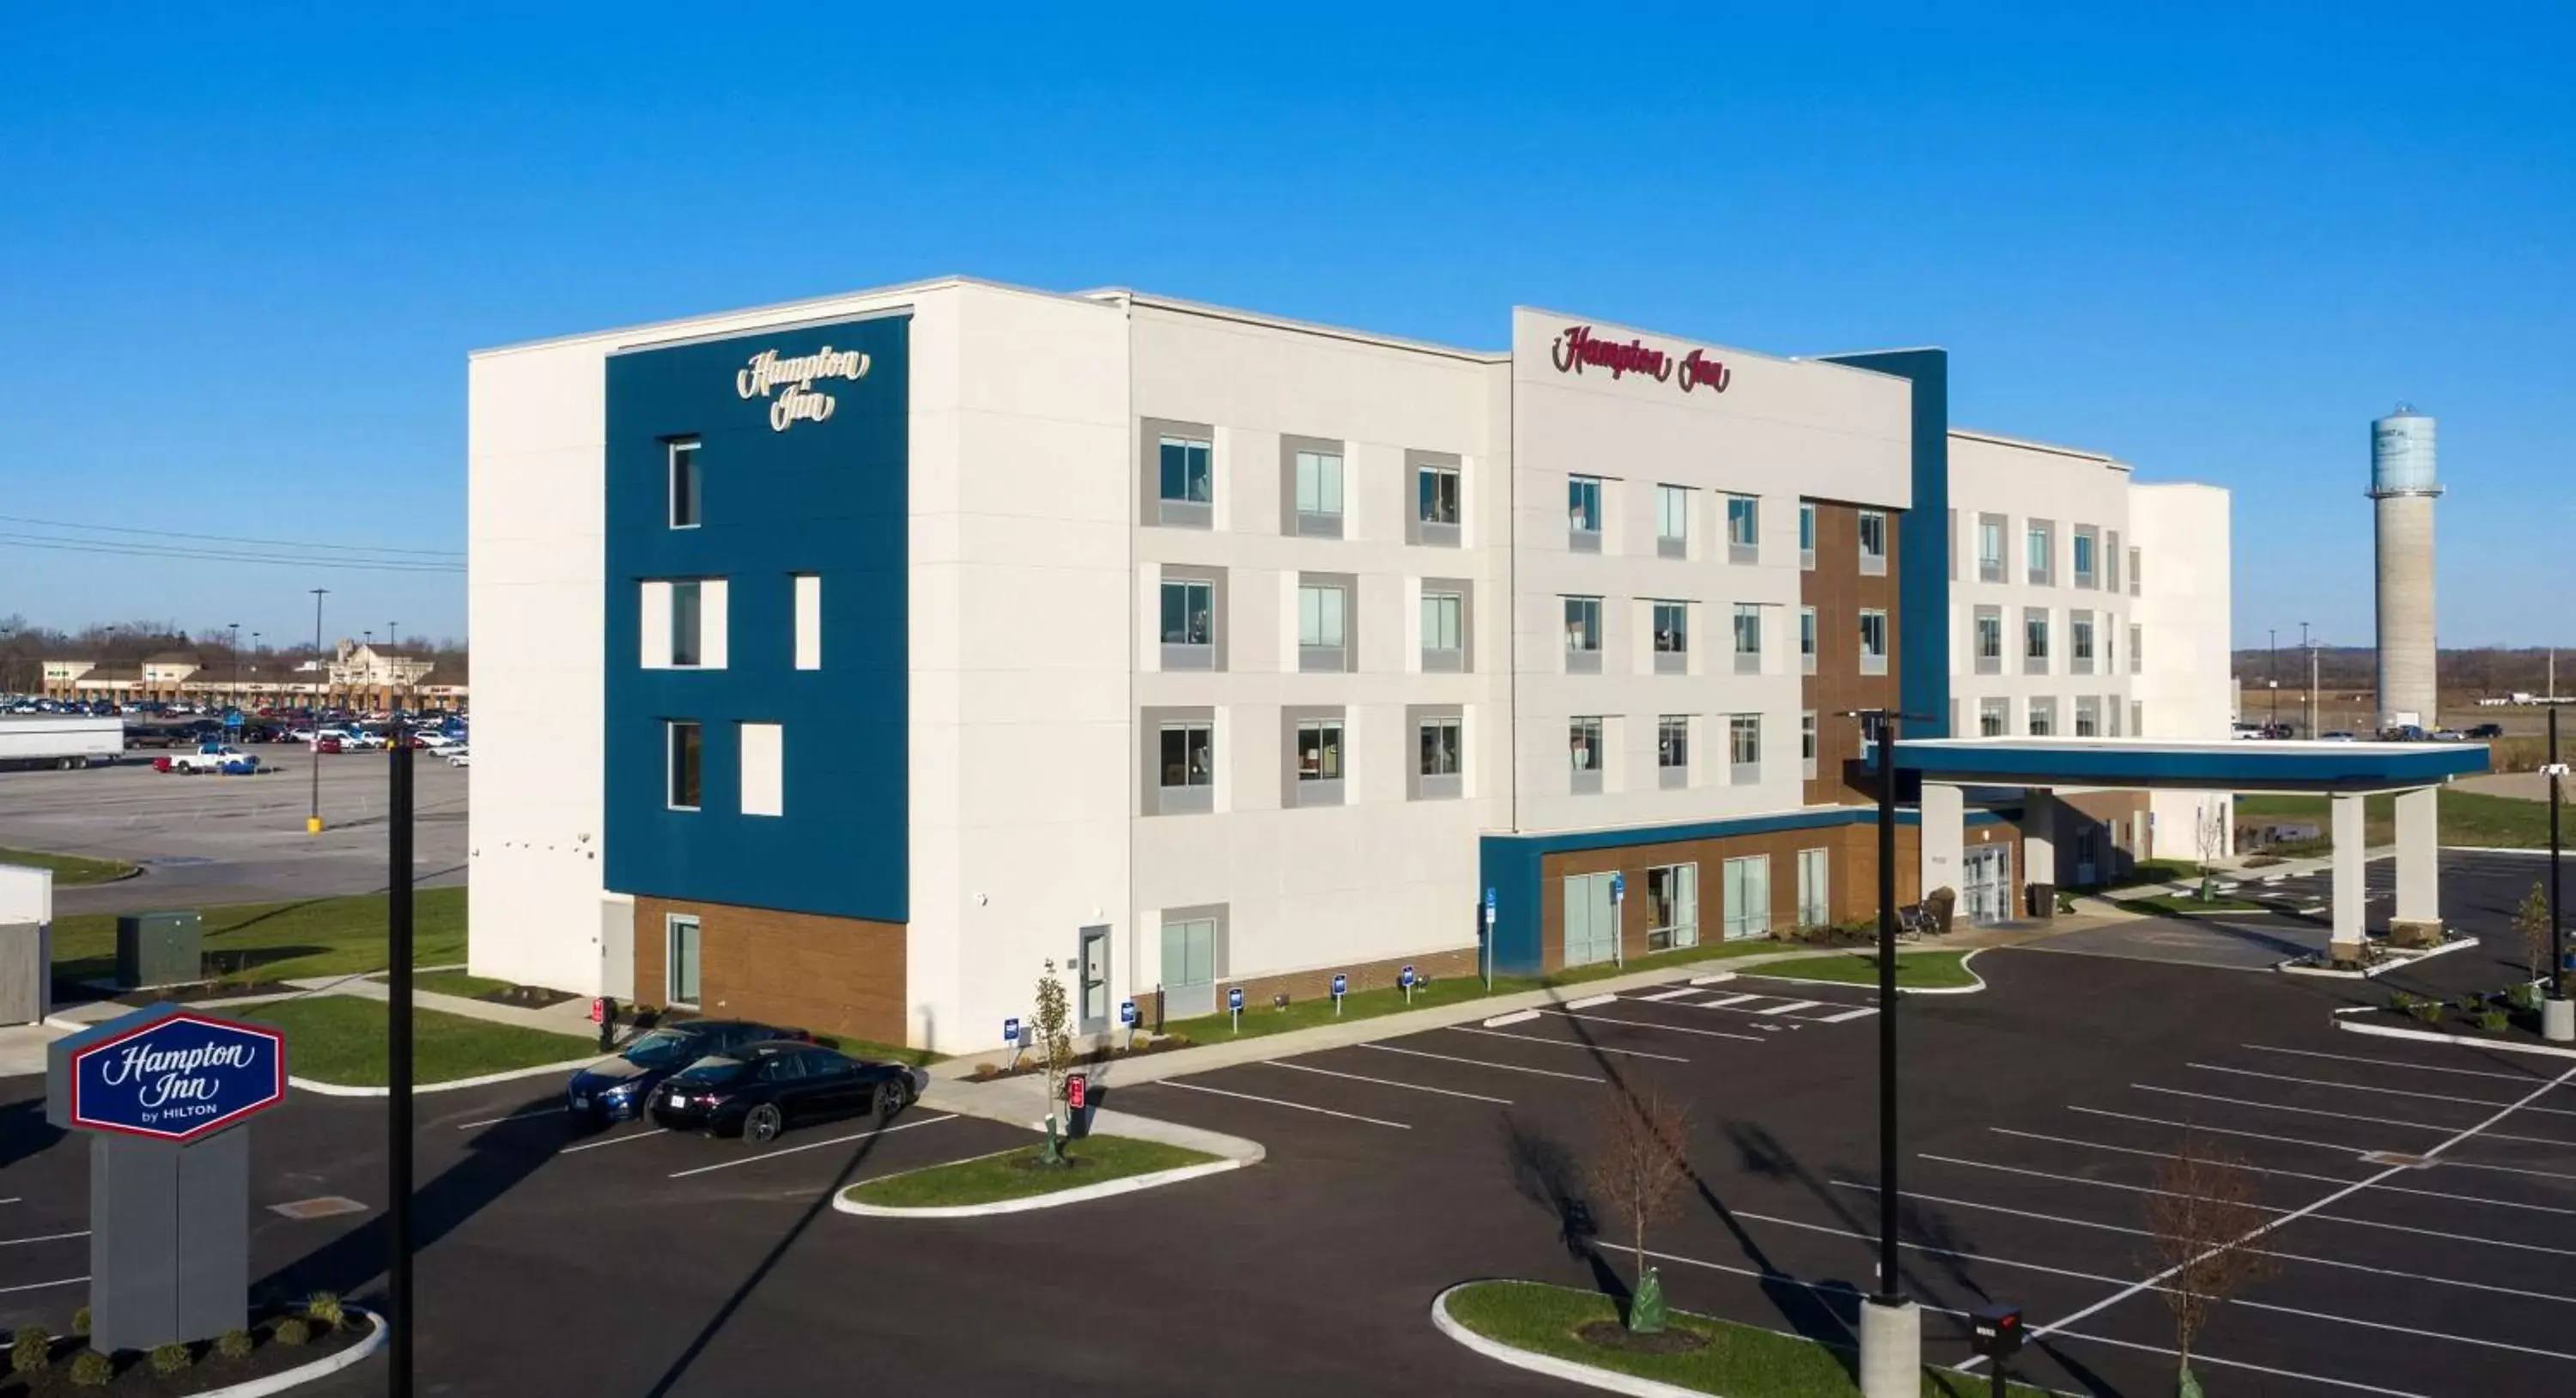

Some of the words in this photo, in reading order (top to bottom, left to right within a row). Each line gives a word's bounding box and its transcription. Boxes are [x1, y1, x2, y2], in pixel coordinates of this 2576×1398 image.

[737, 345, 871, 398] Hampton
[1552, 325, 1673, 383] Hampton
[1678, 349, 1731, 393] Inn
[770, 385, 835, 432] Inn
[102, 1041, 255, 1086] Hampton
[138, 1073, 220, 1108] Inn
[142, 1111, 159, 1124] by
[163, 1103, 217, 1120] HILTON
